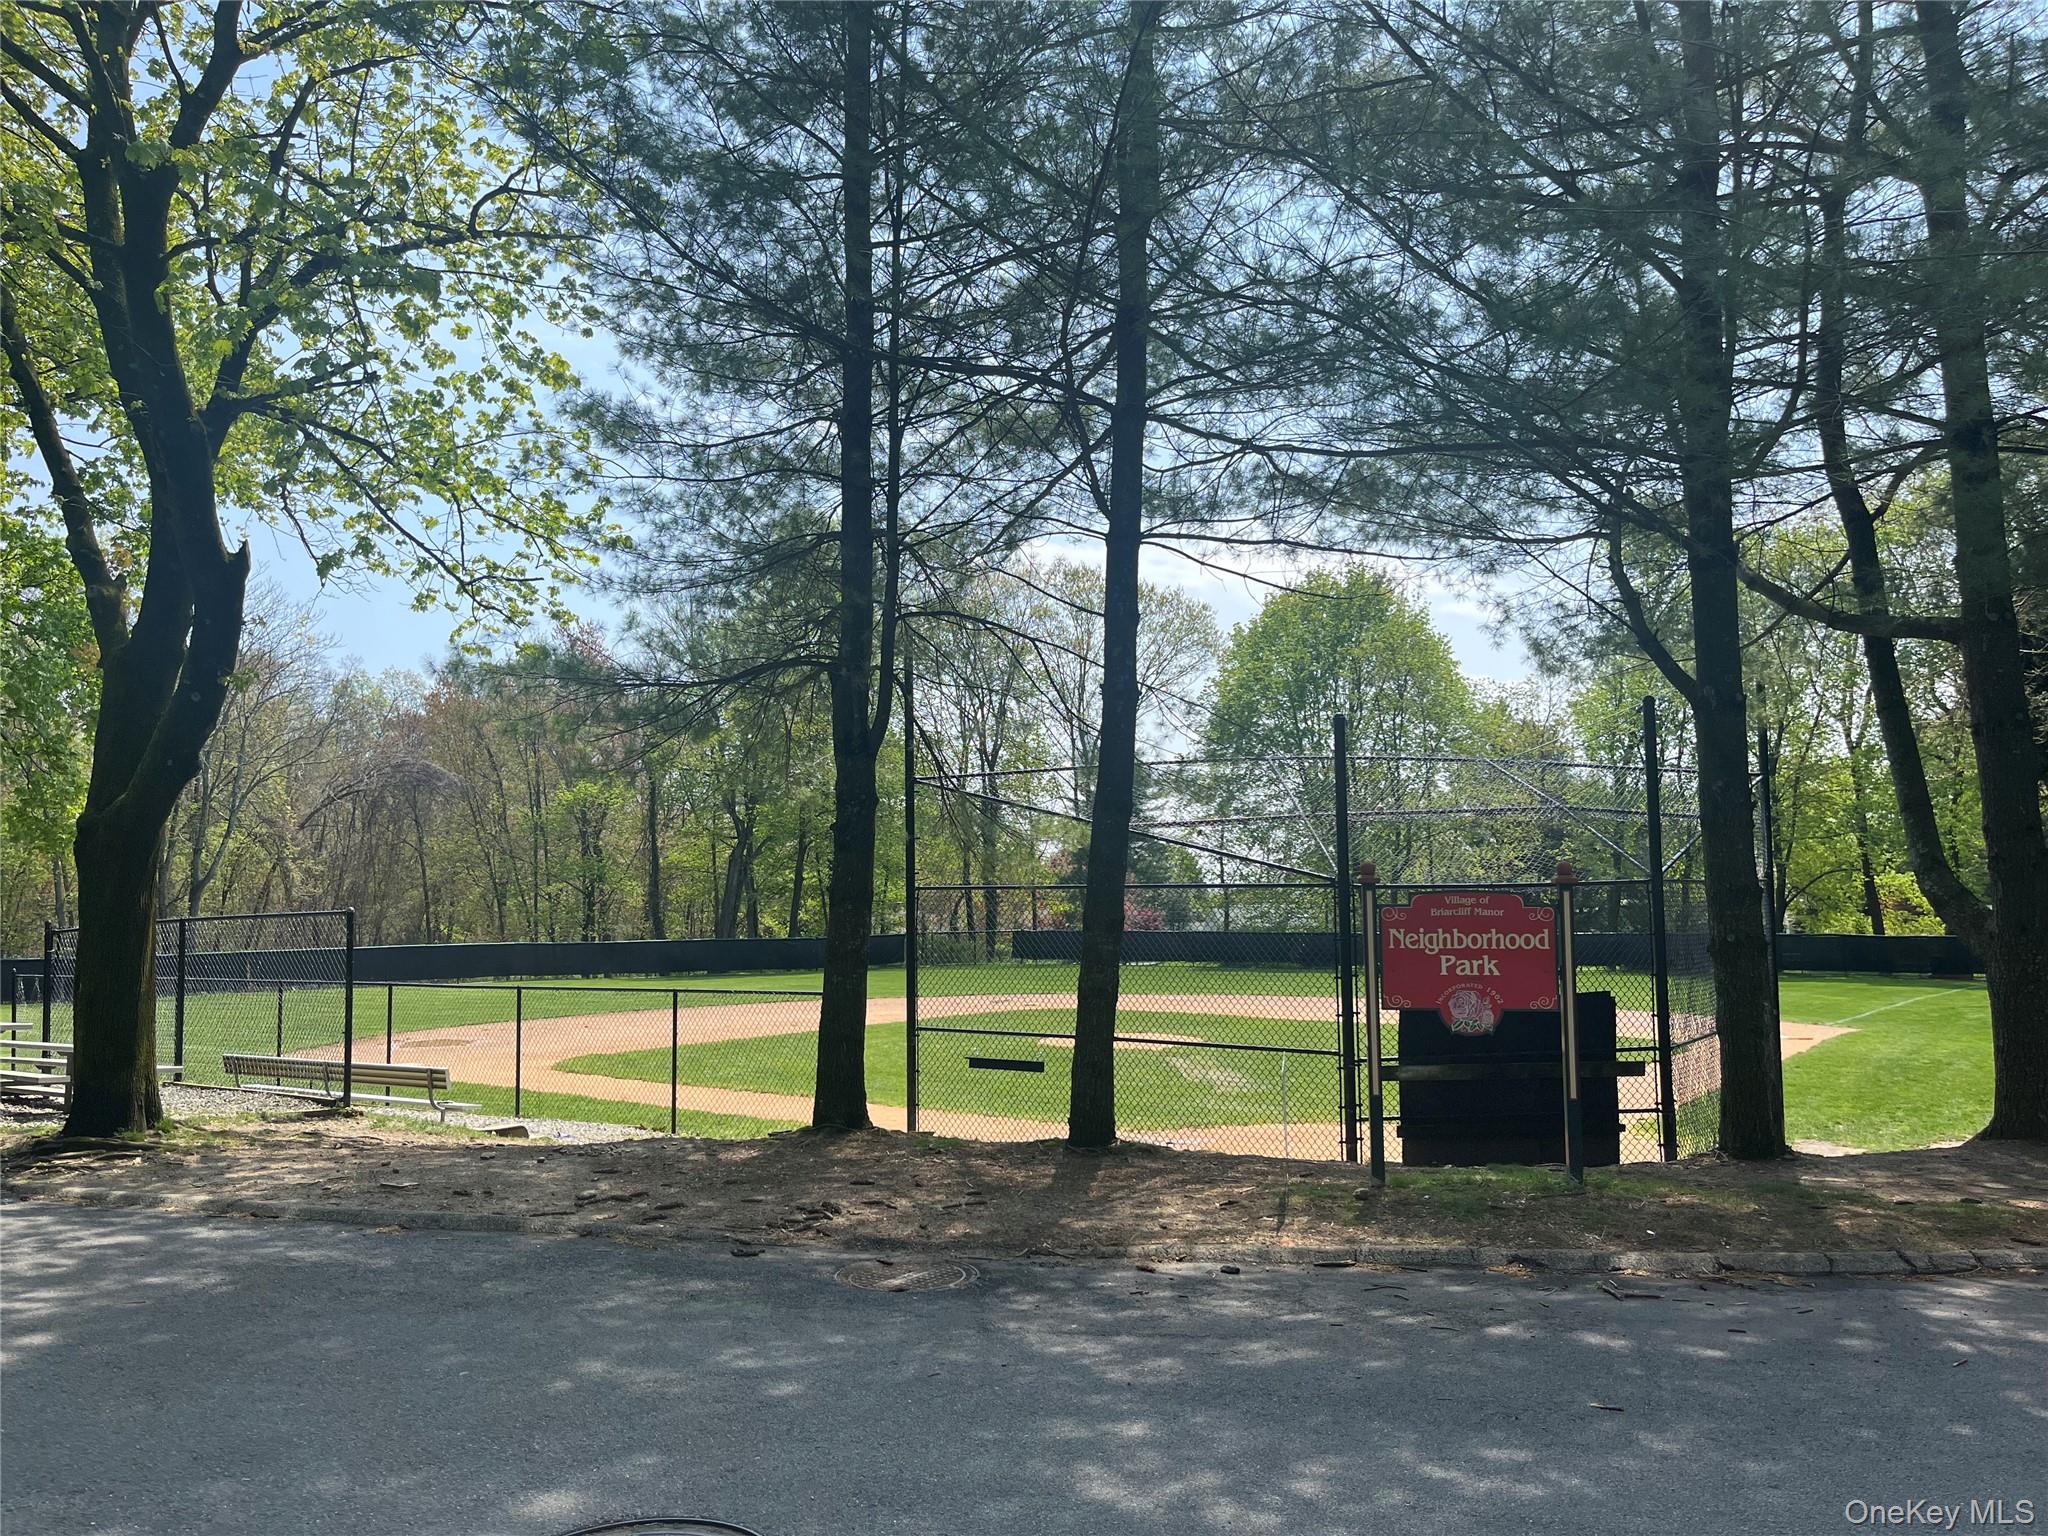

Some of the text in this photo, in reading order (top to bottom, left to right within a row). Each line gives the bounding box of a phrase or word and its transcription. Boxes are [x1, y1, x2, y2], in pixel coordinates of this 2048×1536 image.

[1444, 895, 1490, 906] Village of
[1430, 907, 1504, 917] Briarcliff Manor
[1388, 928, 1551, 955] Neighborhood
[1439, 955, 1501, 976] Park
[1435, 983, 1504, 1005] INCORPORATED 1902
